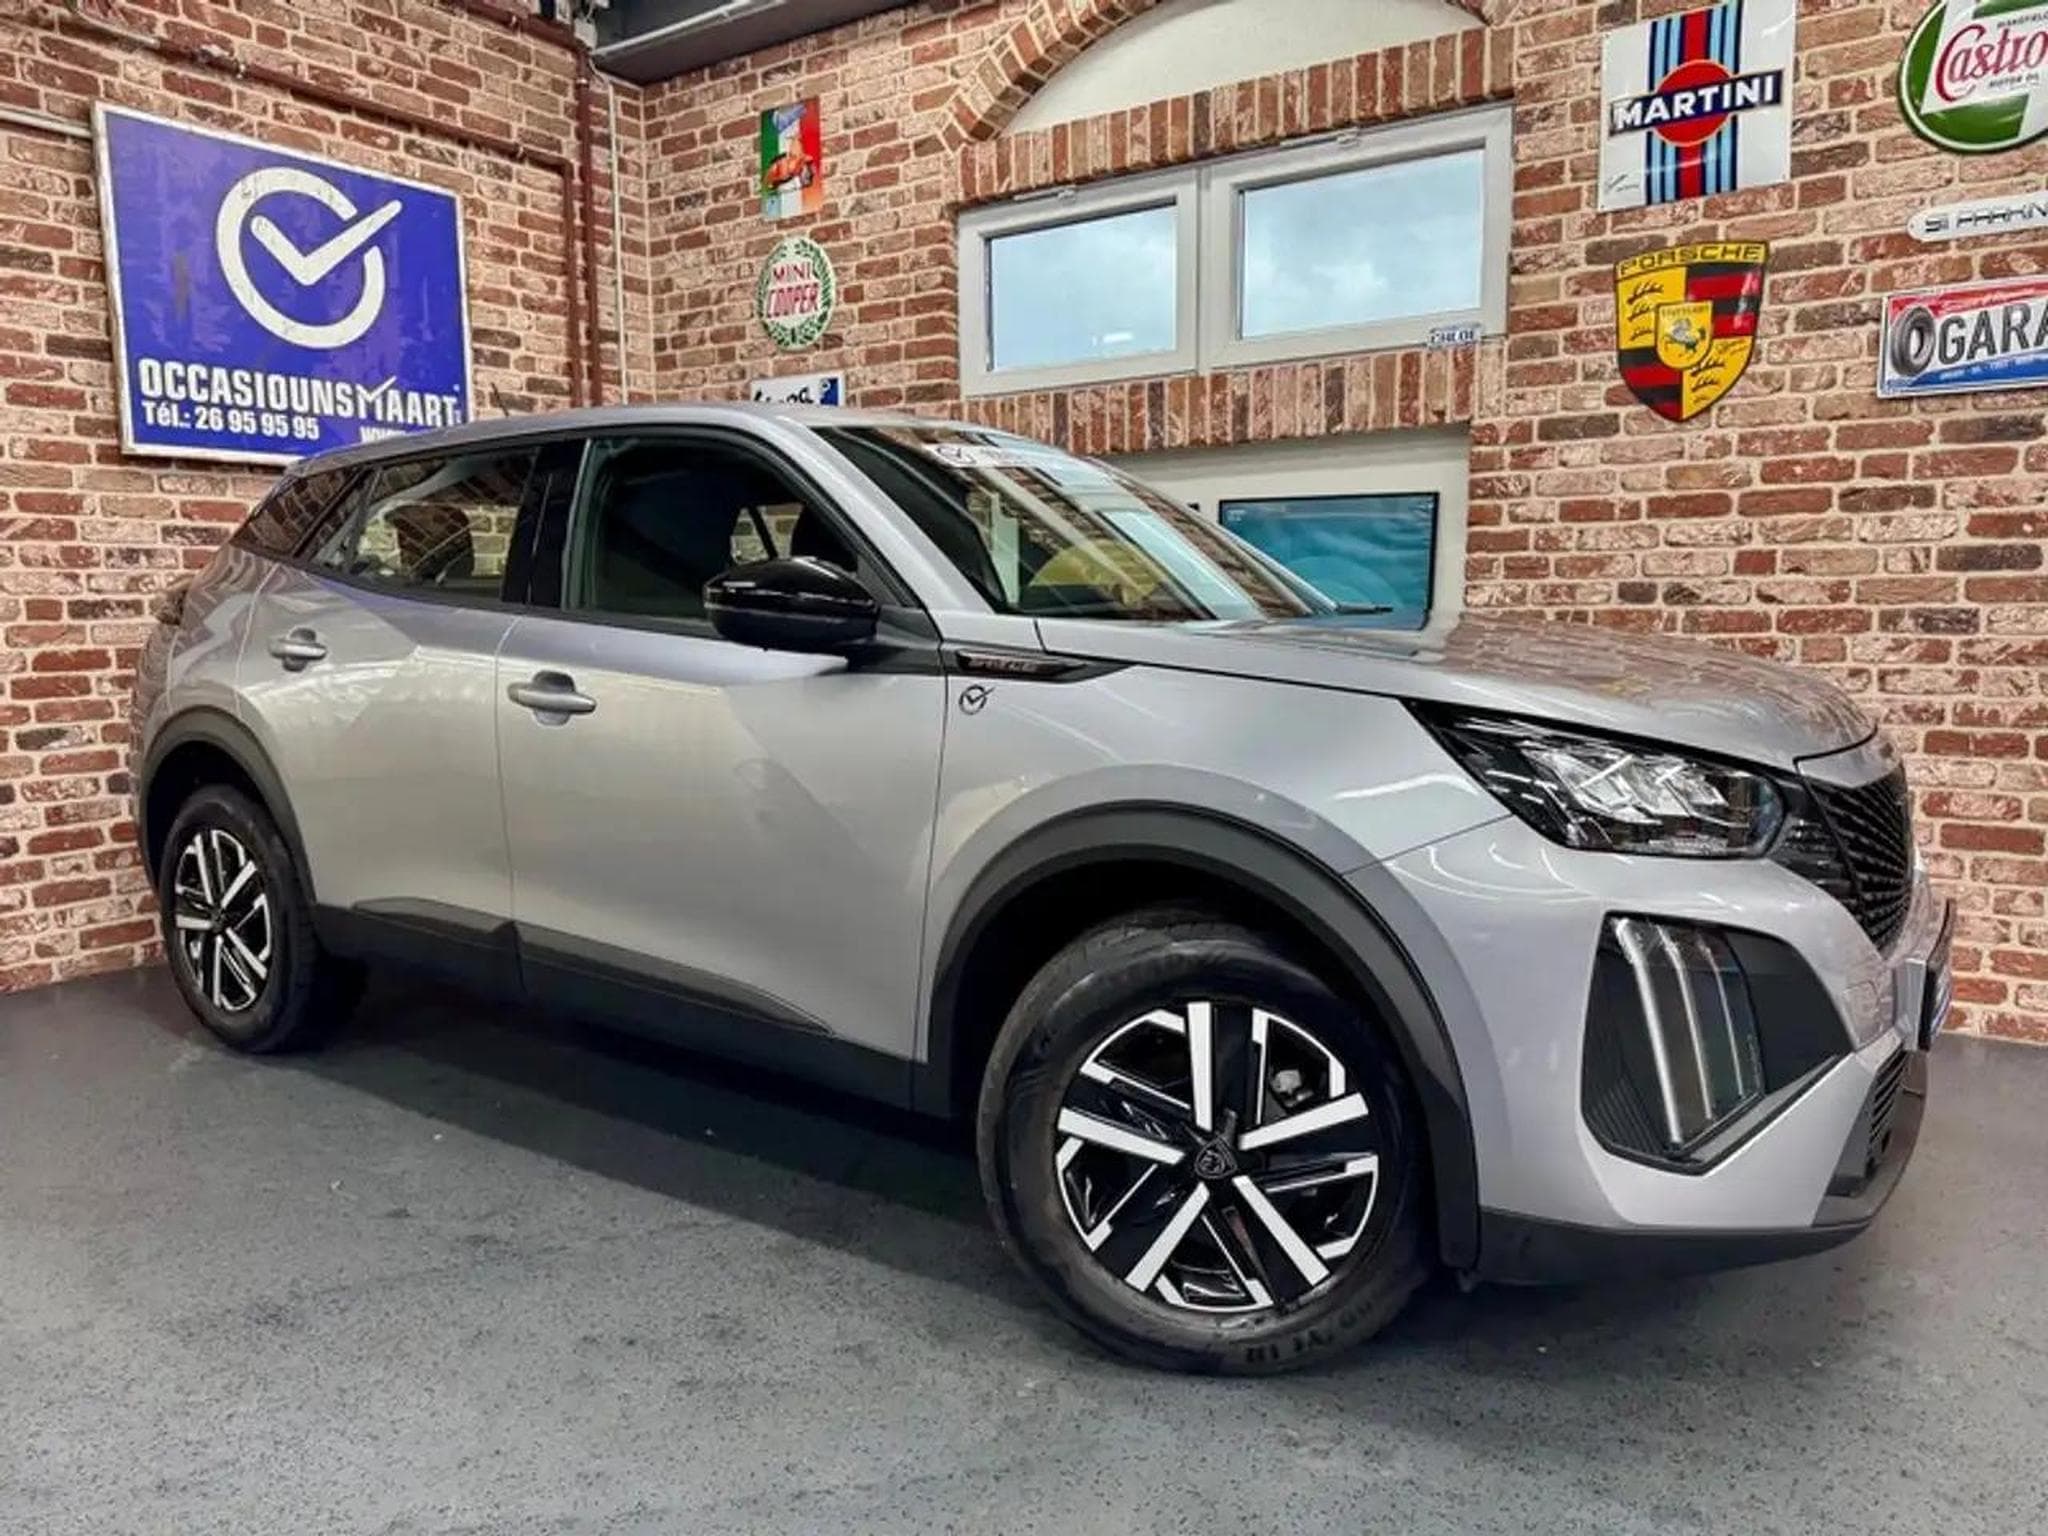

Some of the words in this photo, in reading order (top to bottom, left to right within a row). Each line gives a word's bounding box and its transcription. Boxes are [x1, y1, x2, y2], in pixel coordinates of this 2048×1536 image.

[1613, 75, 1774, 129] MARTINI
[771, 261, 811, 281] MINI
[1620, 245, 1761, 275] PORSCHE
[766, 282, 819, 319] COOPER
[194, 405, 224, 432] 26
[227, 408, 257, 435] 95
[260, 411, 290, 437] 95
[292, 415, 320, 441] 95
